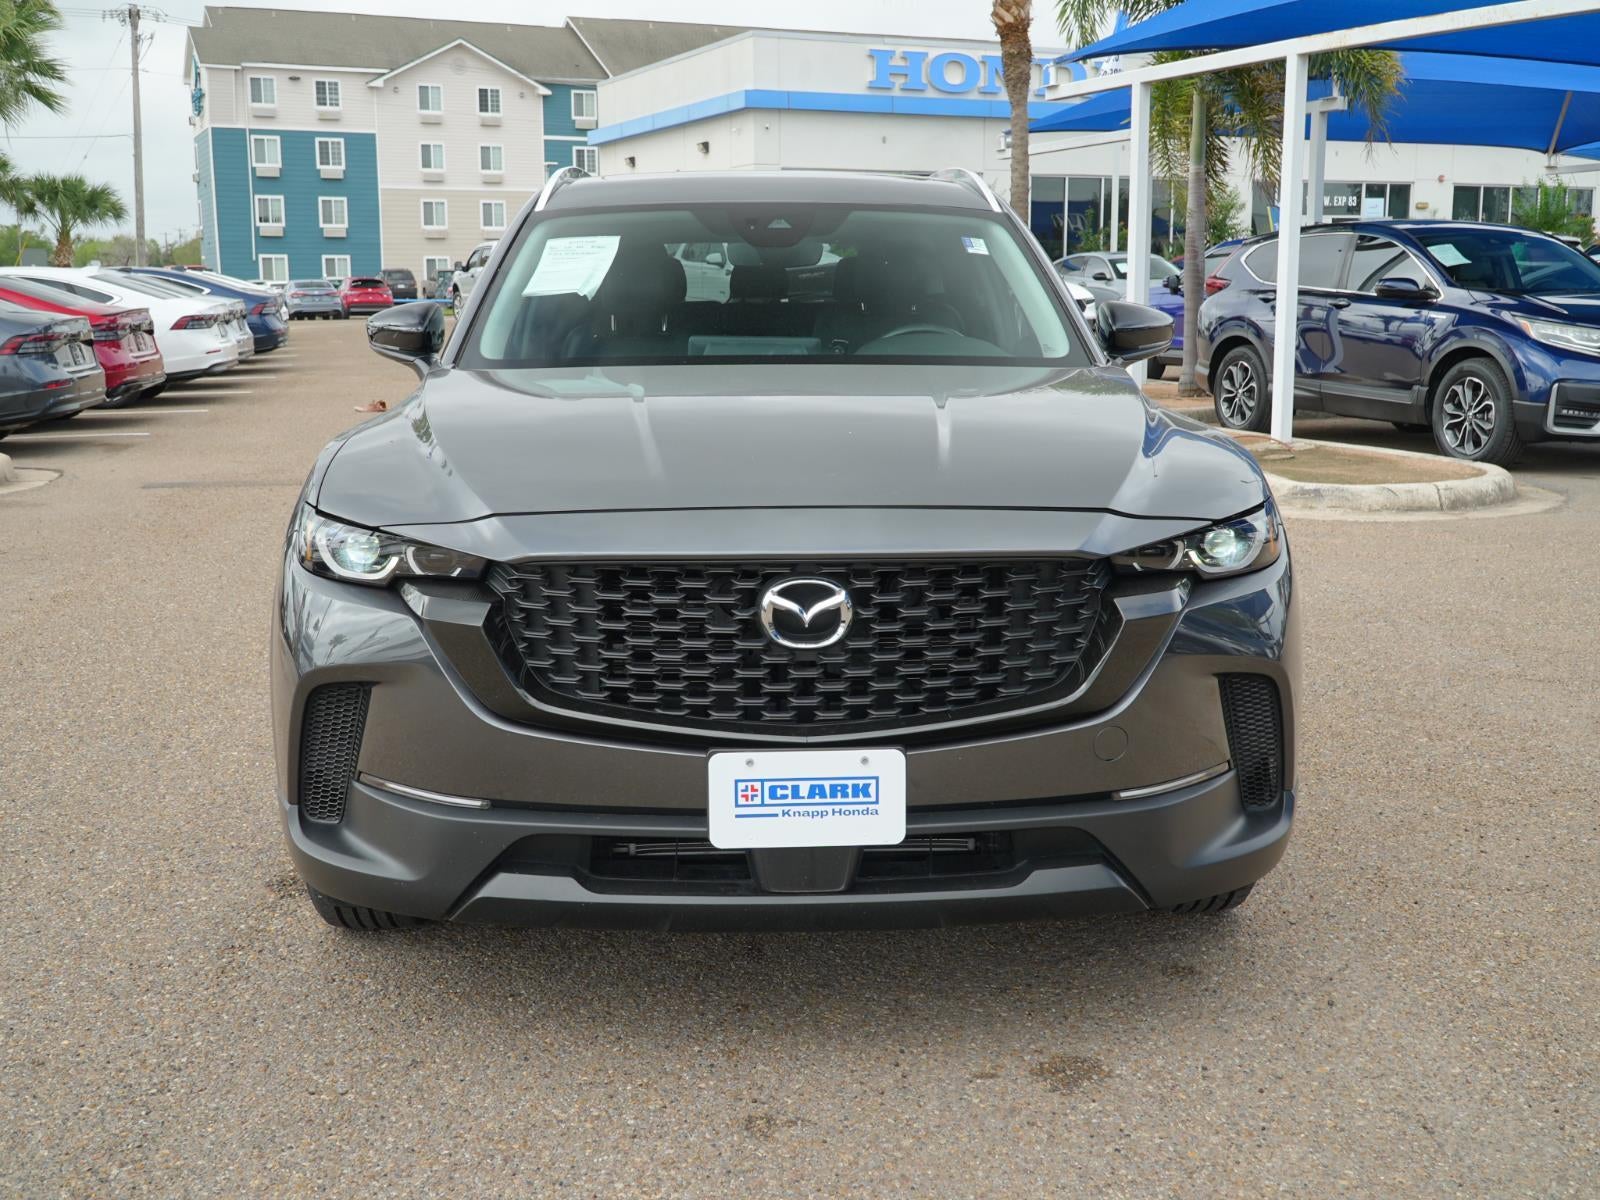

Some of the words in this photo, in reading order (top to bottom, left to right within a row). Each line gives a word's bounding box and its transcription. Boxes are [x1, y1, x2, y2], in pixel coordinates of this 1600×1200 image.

[1333, 195, 1347, 207] EXP
[1348, 195, 1357, 207] 83
[768, 783, 872, 801] CLARK
[781, 808, 829, 819] Knapp
[831, 807, 879, 817] Honda
